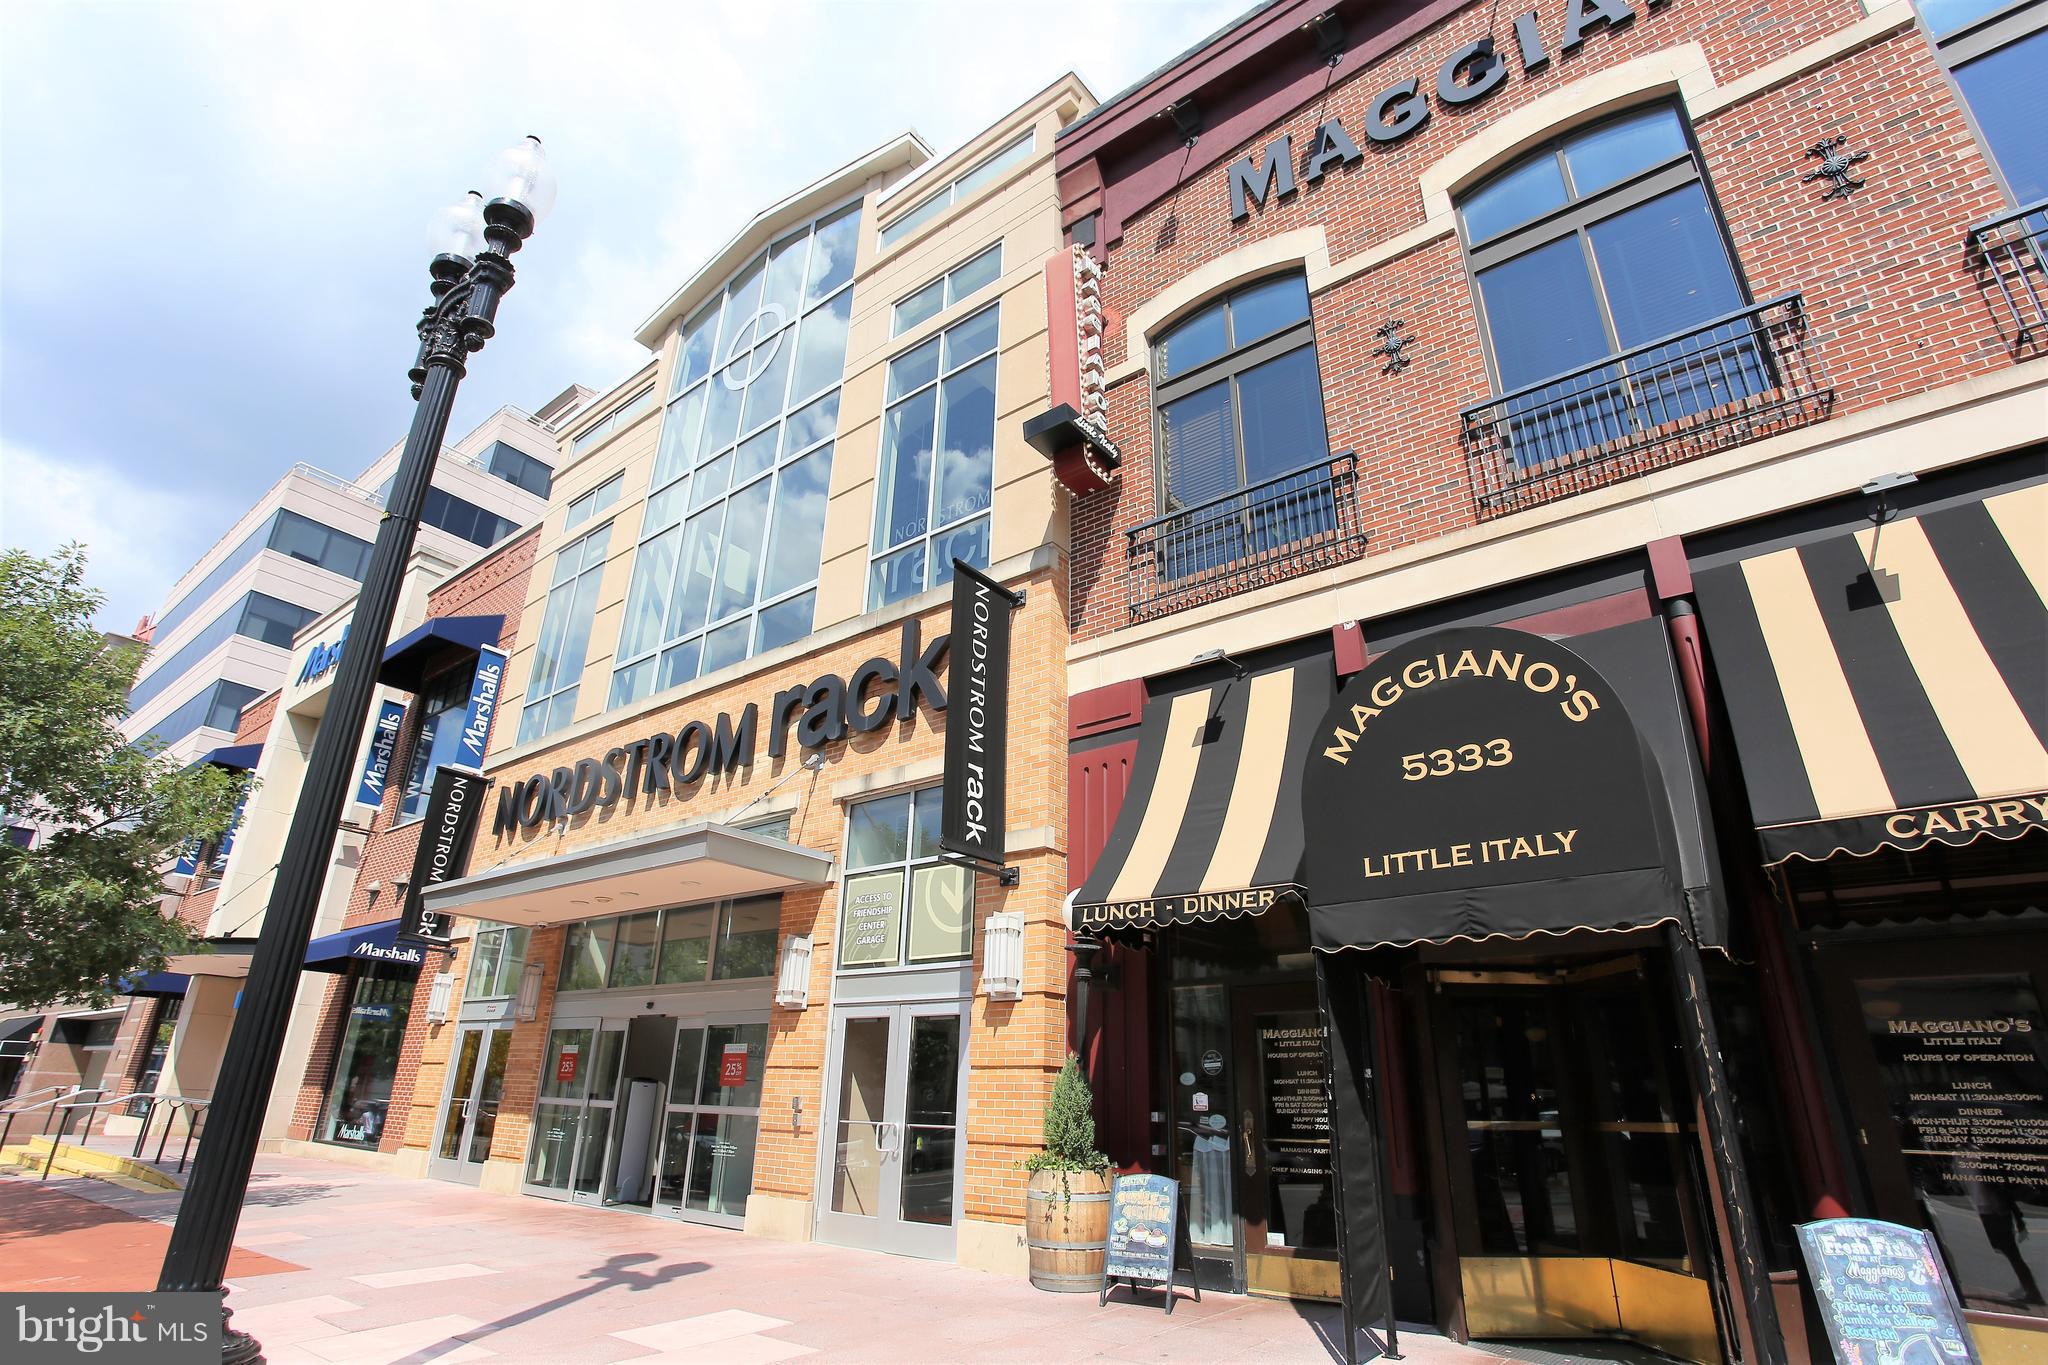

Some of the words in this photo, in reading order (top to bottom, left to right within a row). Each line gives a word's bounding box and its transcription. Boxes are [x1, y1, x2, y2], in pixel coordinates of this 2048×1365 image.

[1227, 0, 1637, 224] MAGGIA
[895, 489, 990, 542] NORSTROM
[967, 582, 991, 752] NORDSTROM
[462, 663, 500, 756] Marshalls
[1323, 649, 1600, 765] MAGGIANO'S
[493, 702, 758, 836] NORDSTROM
[769, 619, 949, 758] rack
[364, 713, 400, 795] Marshalls
[1402, 738, 1513, 781] 5333
[965, 763, 987, 845] rack
[1885, 797, 2048, 839] CARRY
[429, 777, 468, 882] NORDSTROM
[1363, 843, 1473, 877] LITTLE
[1481, 829, 1578, 863] ITALY
[855, 893, 880, 904] ACCESS
[883, 892, 893, 900] TO
[1082, 901, 1155, 923] LUNCH
[1183, 890, 1275, 914] DINNER
[853, 906, 893, 918] FRIENDSHIP
[418, 911, 437, 935] ck
[858, 921, 885, 930] CENTER
[856, 935, 885, 945] GARAGE
[354, 942, 421, 962] Marshalls
[1888, 1018, 2032, 1034] MAGGIANO'S
[1968, 1037, 2002, 1045] ITALY
[1903, 1054, 1943, 1062] HOURS
[1963, 1054, 2034, 1062] OPERATION
[1952, 1082, 1992, 1090] LUNCH
[1958, 1108, 2004, 1116] DINNER
[337, 1124, 365, 1141] Marshalls
[1918, 1126, 1937, 1134] FRI
[1923, 1136, 1968, 1144] SUNDAY
[1959, 1162, 1998, 1170] 3:00PM
[2005, 1163, 2046, 1172] 7:00PM
[1943, 1173, 2005, 1183] MANAGING
[1821, 1235, 1870, 1255] Fresh
[1870, 1236, 1915, 1258] Fish
[1847, 1262, 1905, 1282] Maggianos
[1848, 1285, 1888, 1301] Atlantic
[1890, 1287, 1930, 1302] Salmon
[1885, 1303, 1906, 1313] COD
[1839, 1313, 1872, 1326] Jumbo
[1874, 1313, 1892, 1325] Sea
